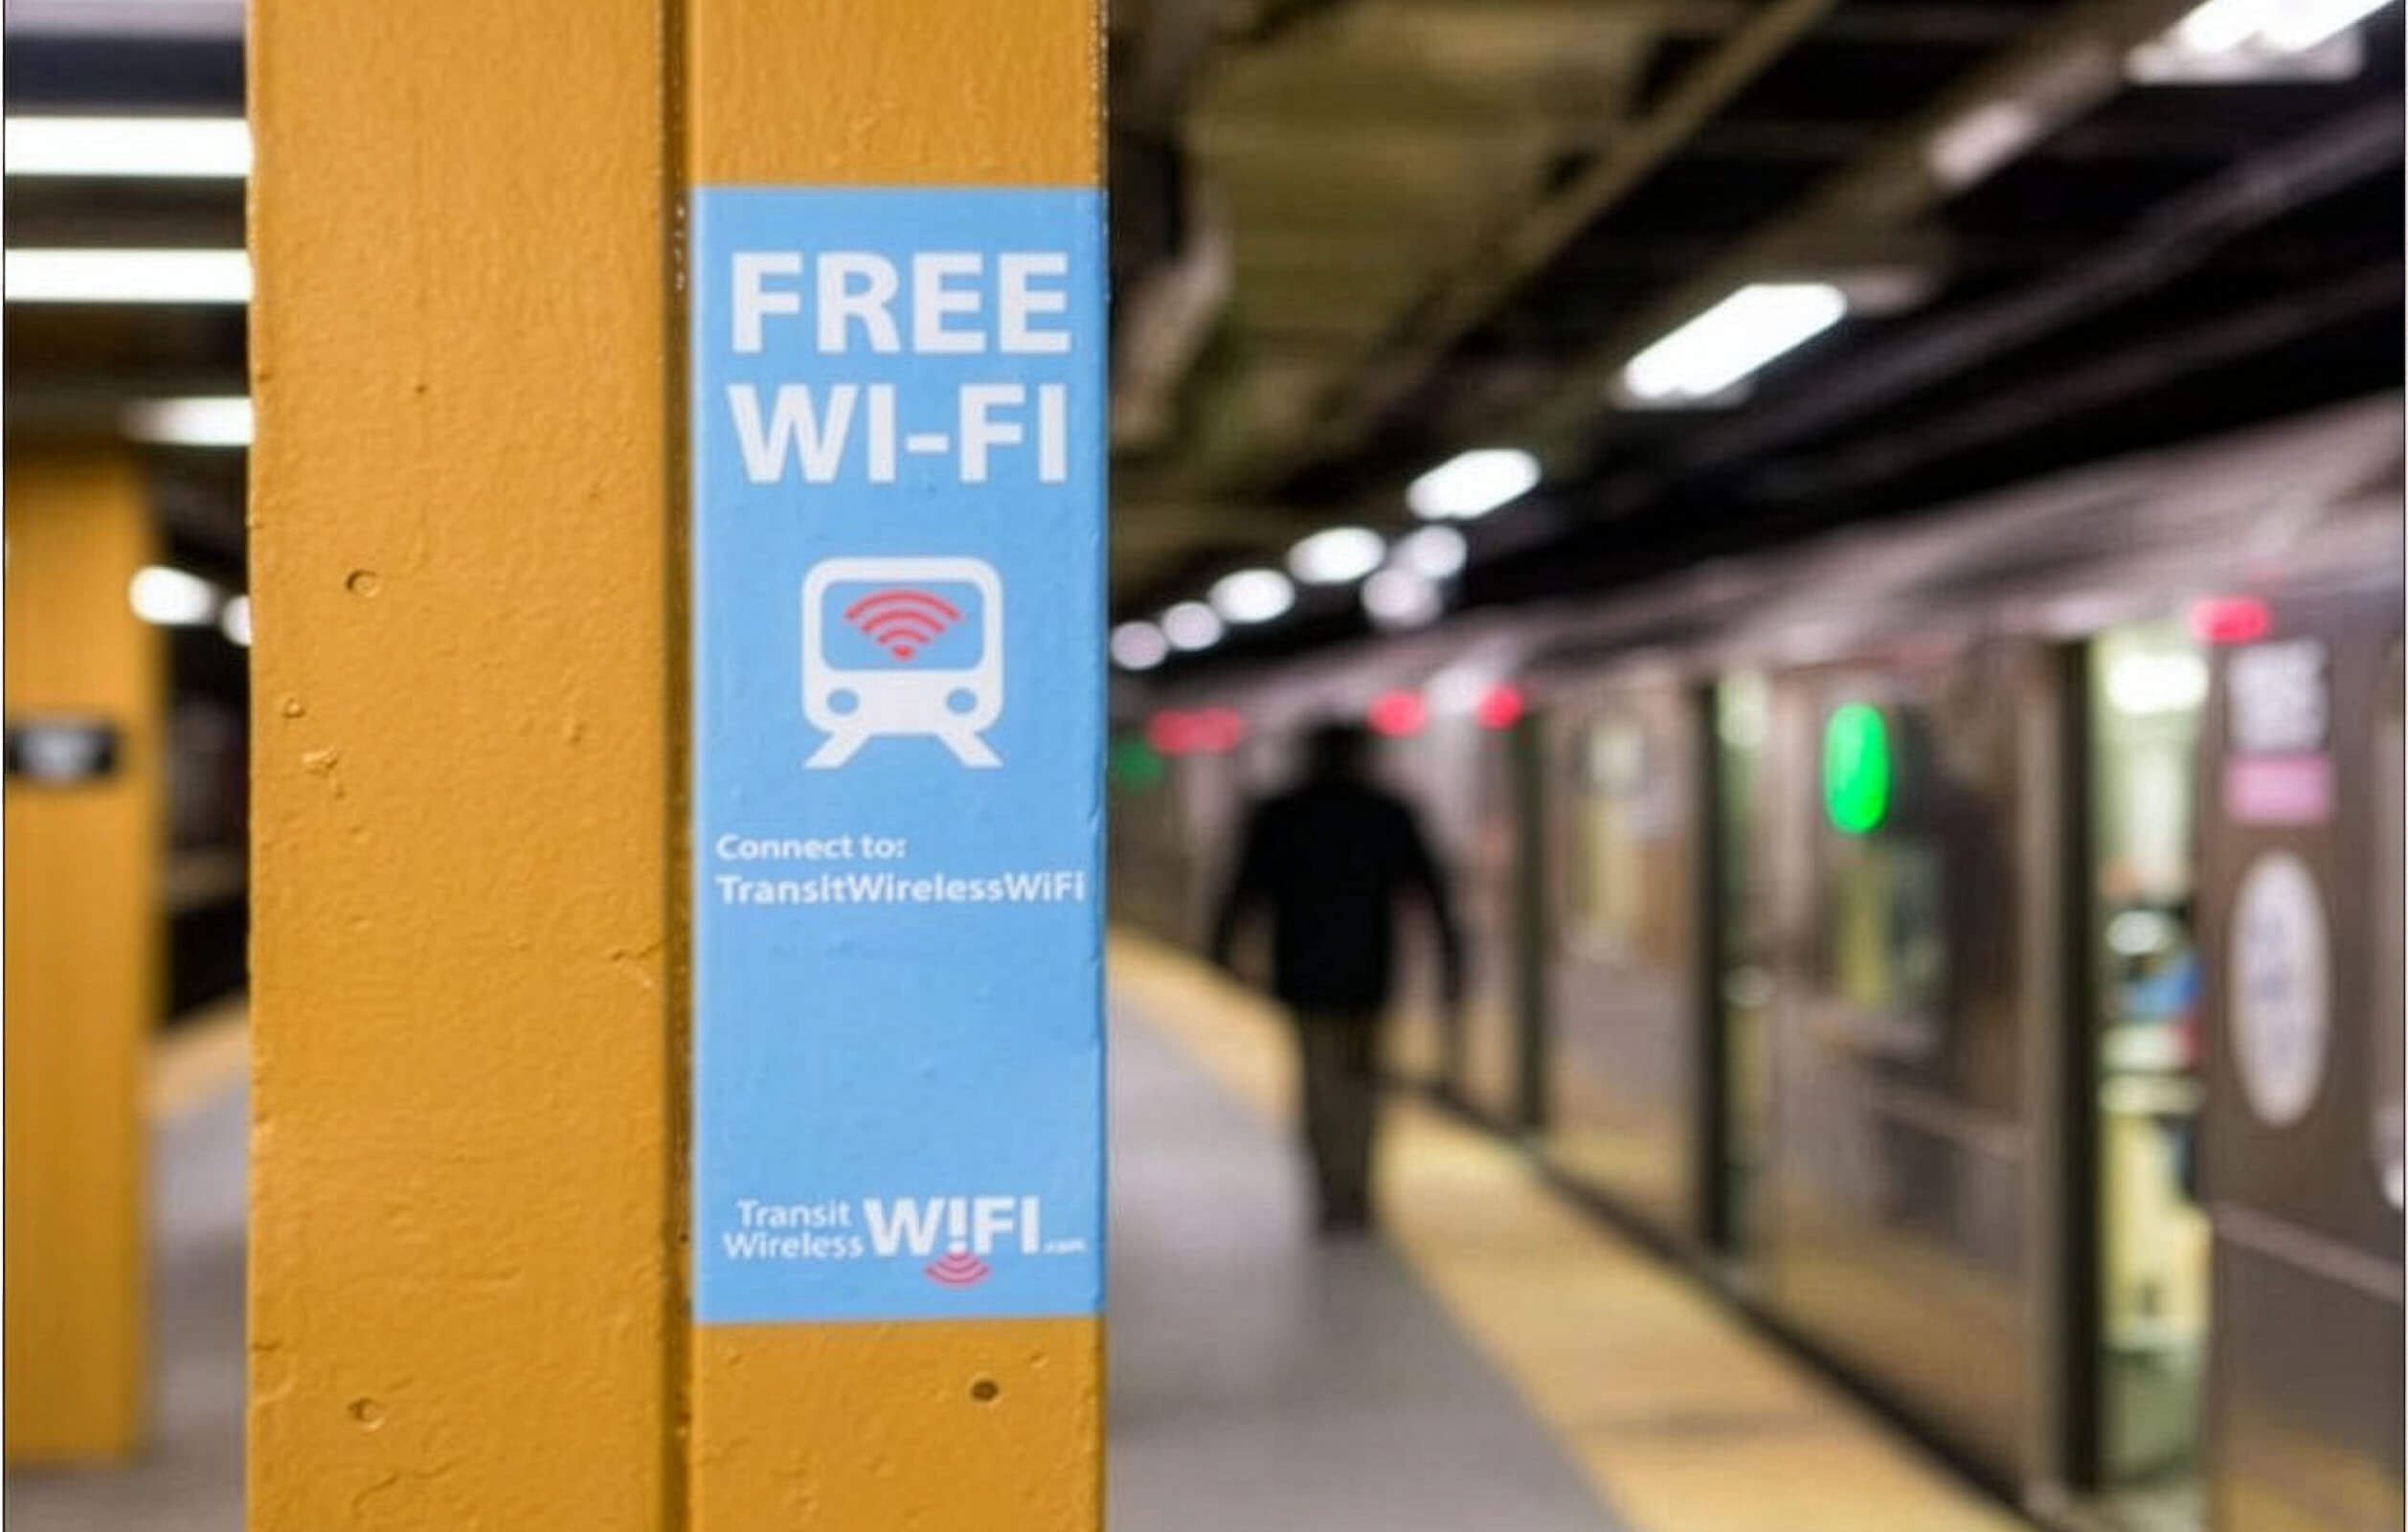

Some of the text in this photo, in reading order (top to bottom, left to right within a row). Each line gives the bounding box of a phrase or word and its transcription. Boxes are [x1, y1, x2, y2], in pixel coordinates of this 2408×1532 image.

[731, 252, 1070, 354] FREE
[728, 384, 1068, 483] WI-FI
[715, 834, 907, 859] Connect to:
[715, 872, 1085, 904] TransitWirelessWiFi
[736, 1199, 851, 1228] Transit
[723, 1233, 863, 1259] Wireless
